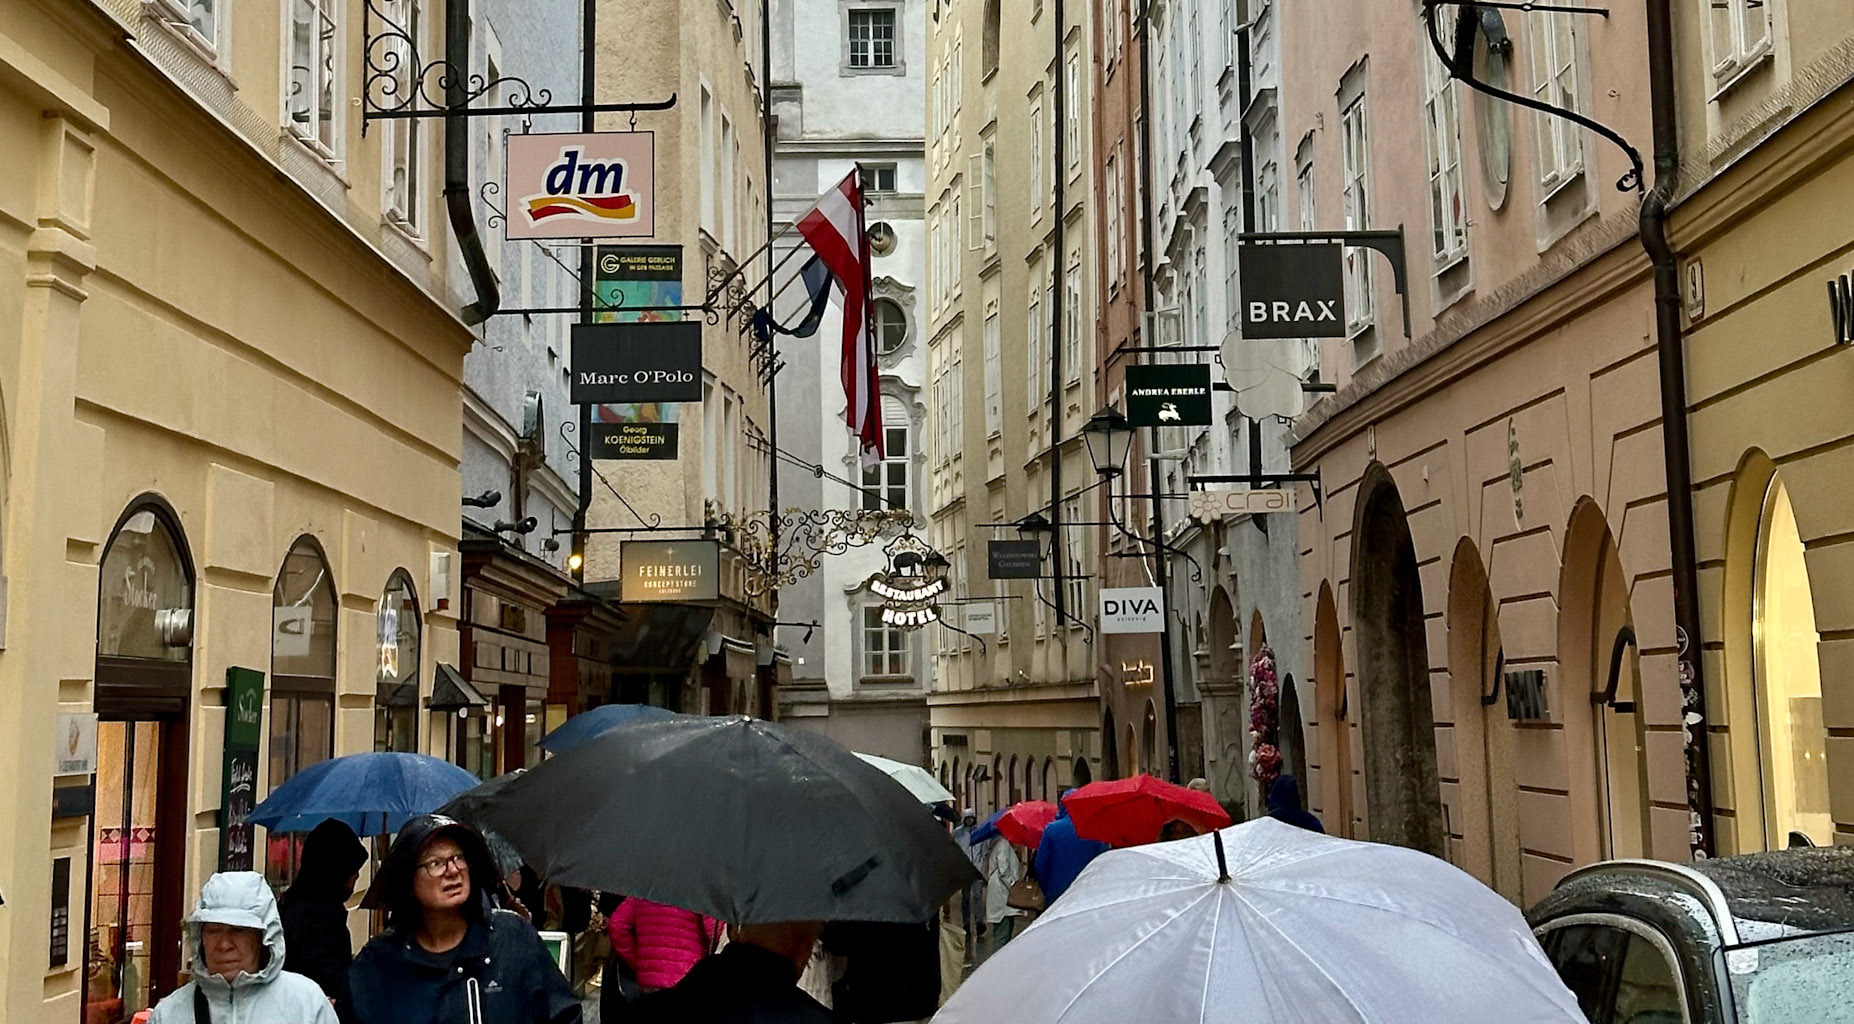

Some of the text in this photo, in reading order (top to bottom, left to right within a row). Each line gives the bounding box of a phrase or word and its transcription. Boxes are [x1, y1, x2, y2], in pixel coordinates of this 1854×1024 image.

[546, 150, 623, 195] dm
[1249, 299, 1337, 324] BRAX
[579, 370, 694, 385] Marc O'Polo
[1132, 387, 1206, 396] ANDREA EBERLE
[622, 425, 648, 435] Georg
[604, 435, 665, 445] KOENIGSTEIN
[639, 564, 702, 577] FEINERLEI
[870, 579, 944, 601] RESTAURANT
[1104, 598, 1160, 616] DIVA
[881, 607, 937, 626] HOTEL
